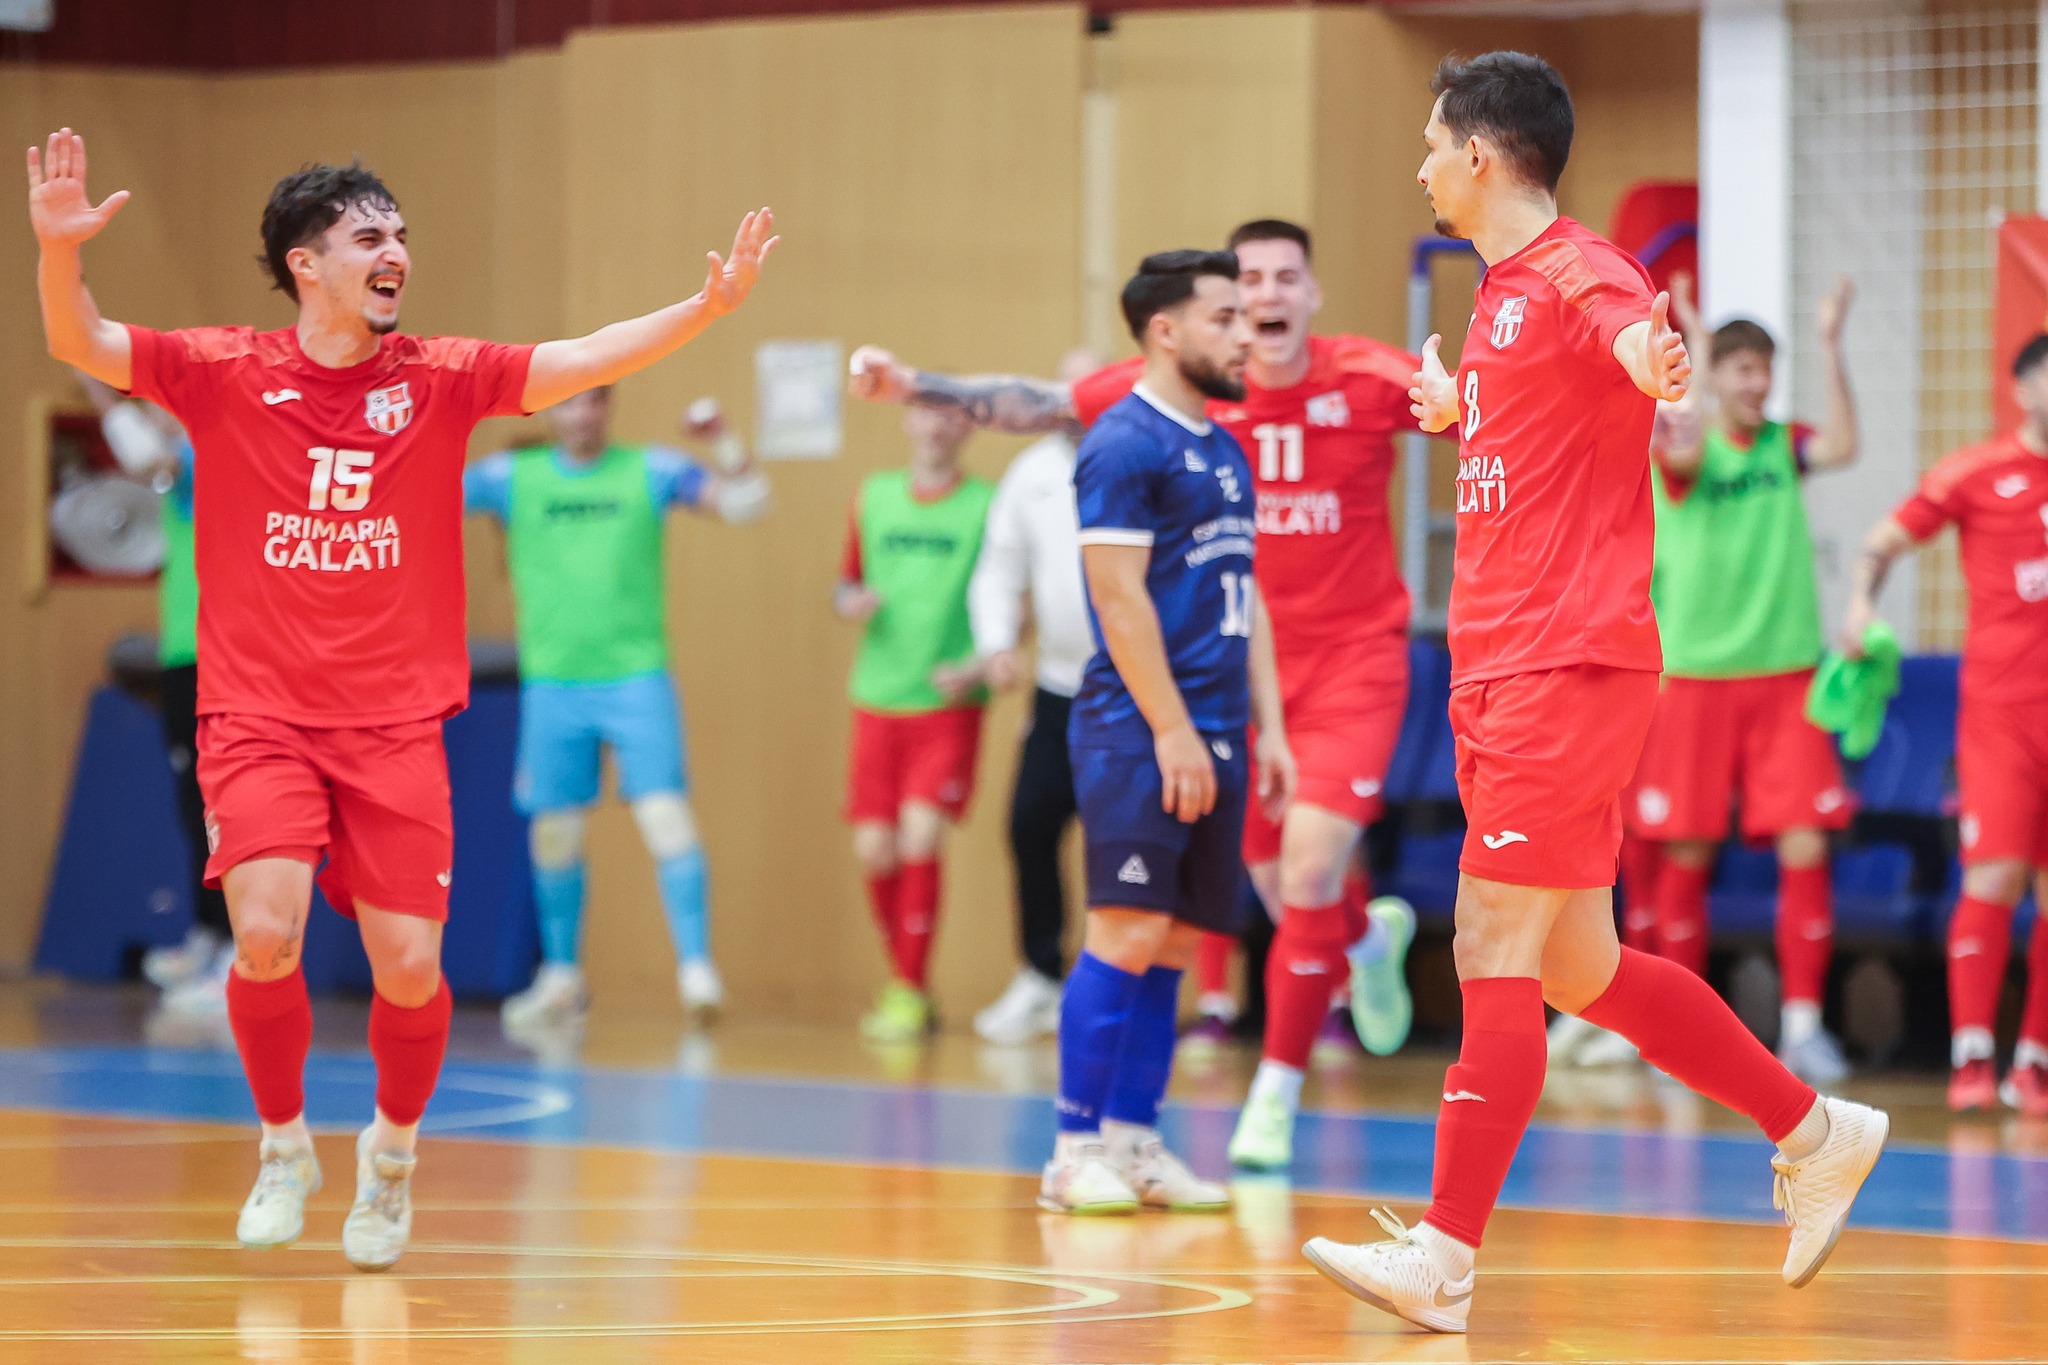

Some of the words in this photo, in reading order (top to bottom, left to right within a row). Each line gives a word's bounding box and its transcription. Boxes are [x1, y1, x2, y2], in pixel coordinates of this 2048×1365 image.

[1463, 369, 1481, 442] 8
[1251, 423, 1304, 482] 11
[307, 446, 375, 511] 15
[1455, 480, 1506, 513] LATI
[265, 511, 399, 543] PRIMARIA
[263, 535, 400, 572] GALATI
